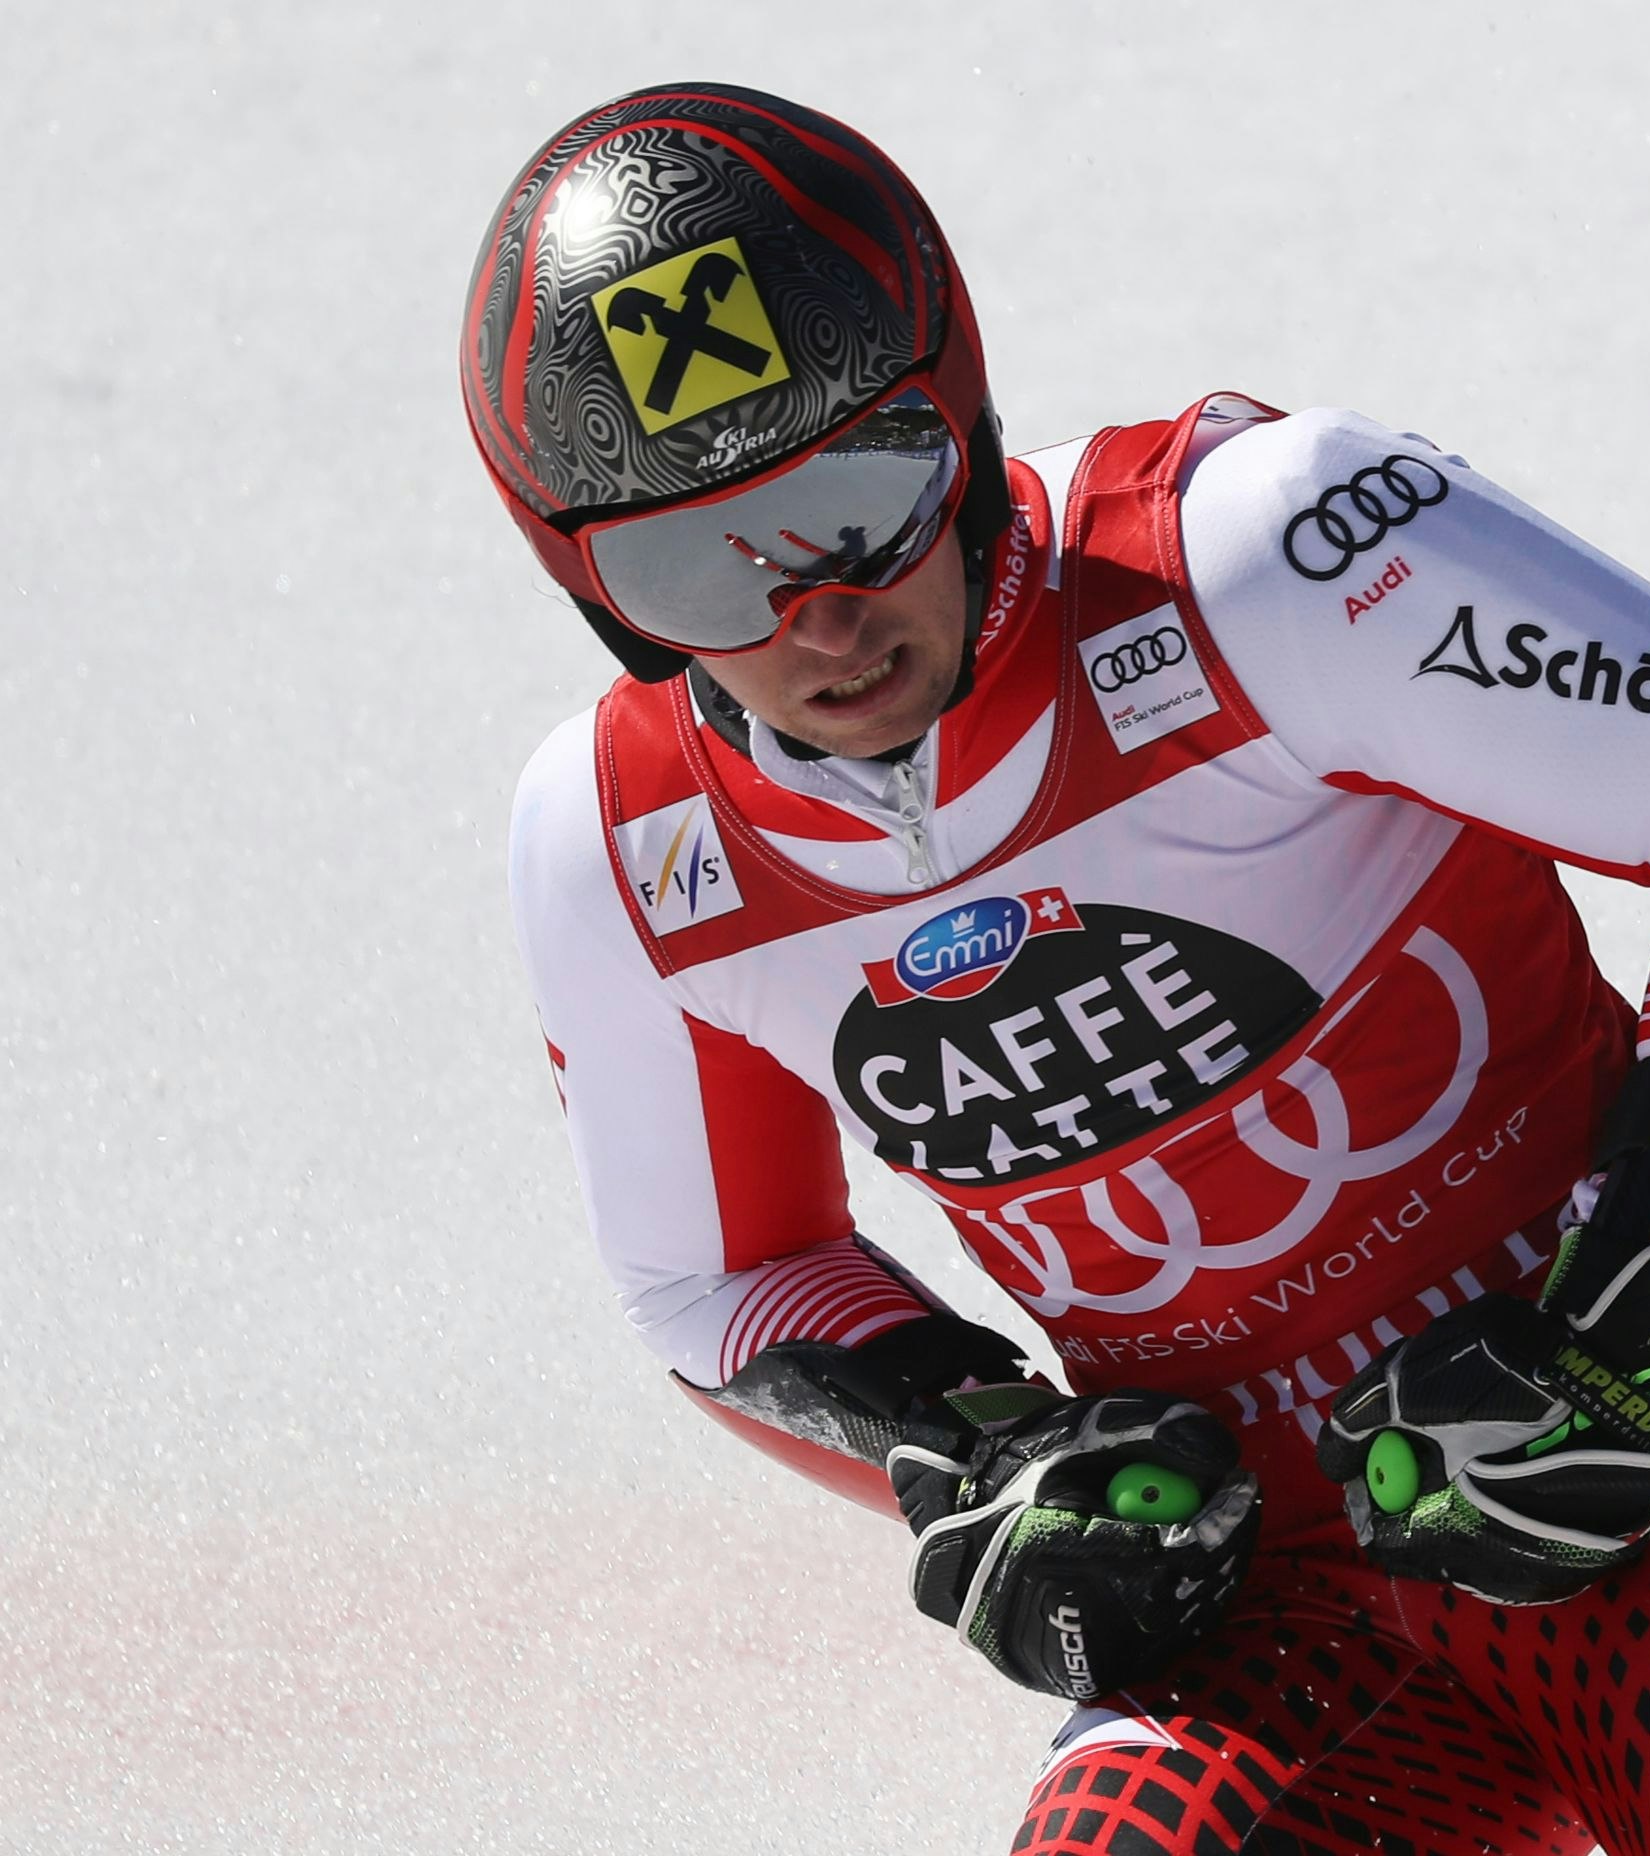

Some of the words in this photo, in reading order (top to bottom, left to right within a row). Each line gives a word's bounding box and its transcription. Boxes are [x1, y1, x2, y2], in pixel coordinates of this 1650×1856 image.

[695, 427, 776, 471] AUSTRIA
[713, 425, 746, 458] SKI
[1344, 555, 1412, 625] Audi
[1112, 705, 1135, 721] Audi
[1114, 717, 1132, 732] FIS
[1133, 710, 1149, 725] Ski
[1149, 695, 1182, 716] World
[1183, 687, 1204, 701] Cup
[639, 857, 720, 907] FIS
[904, 908, 1014, 978] Emmi
[859, 933, 1217, 1126] CAFFÈ
[1052, 1335, 1099, 1365] udi
[1098, 1332, 1175, 1363] FIS
[1173, 1306, 1252, 1350] Ski
[1250, 1189, 1431, 1312] World
[1442, 1105, 1528, 1187] Cup
